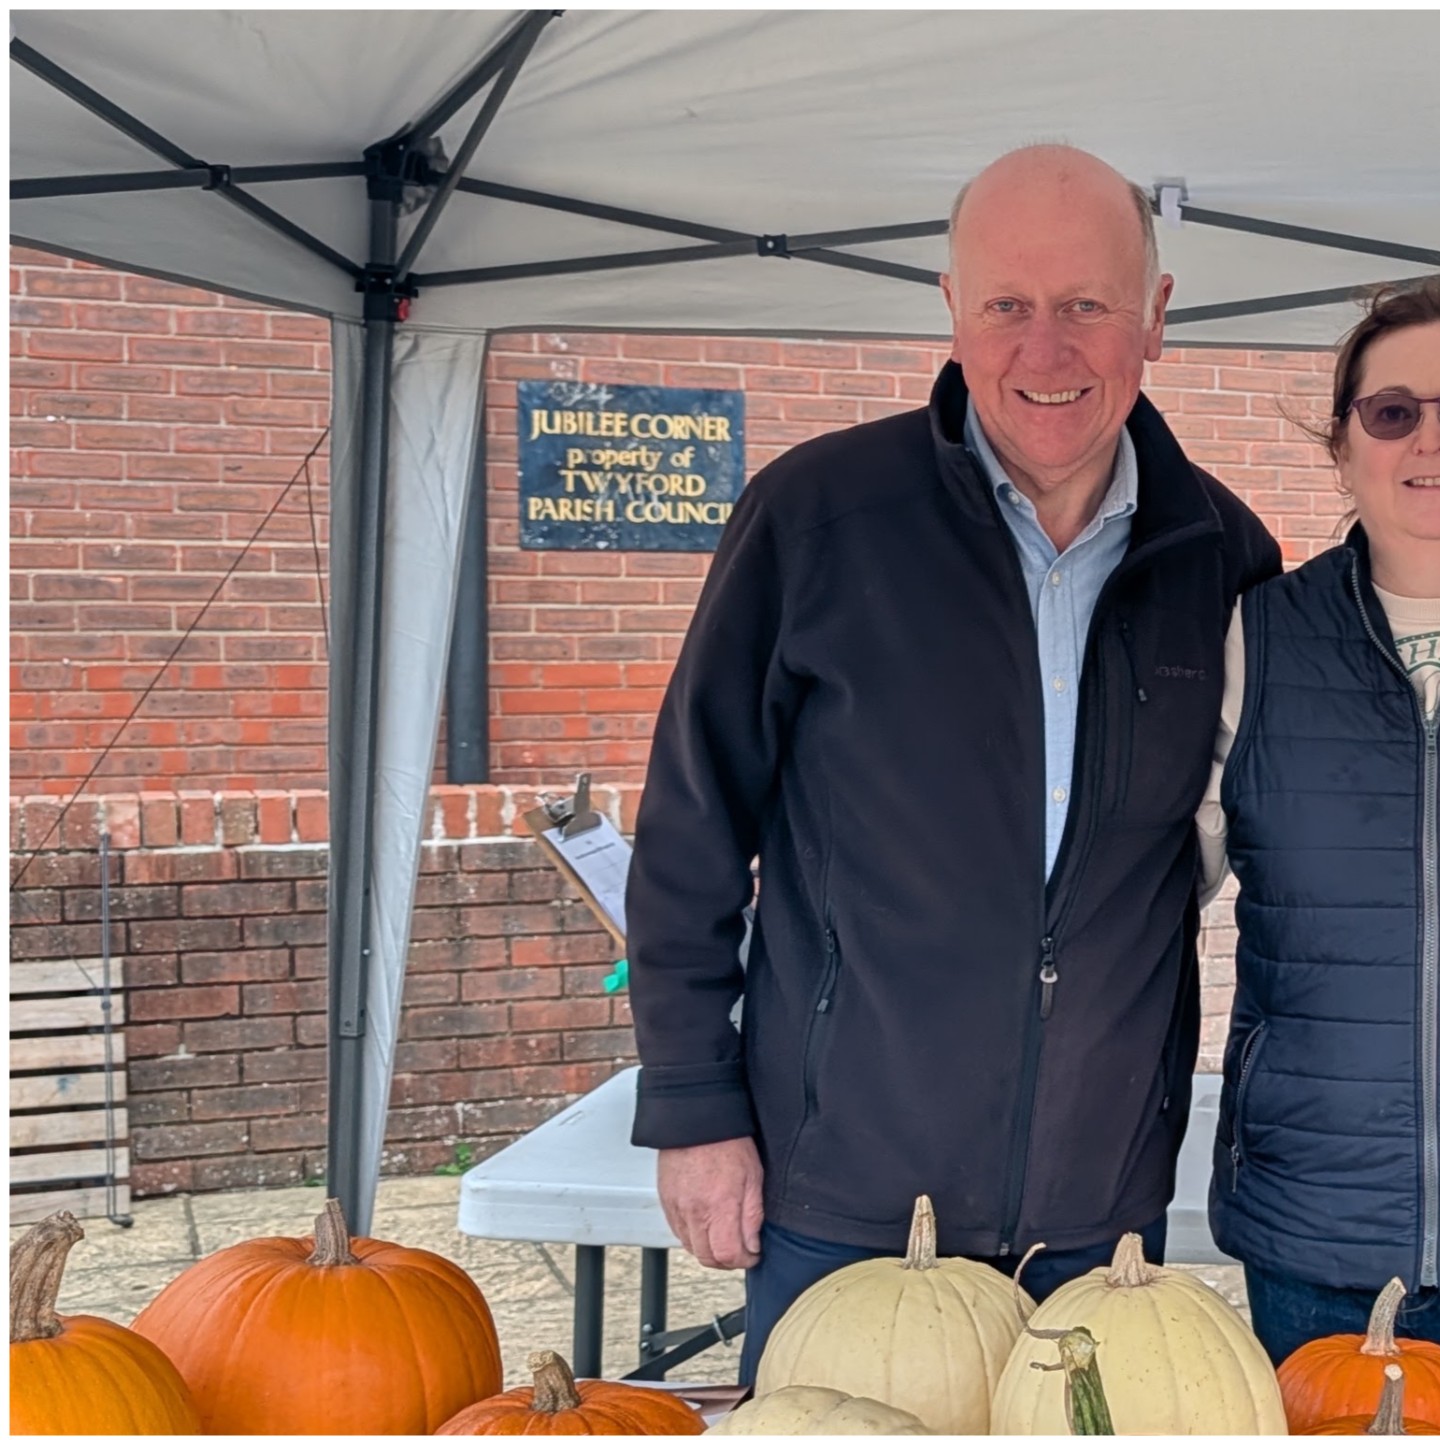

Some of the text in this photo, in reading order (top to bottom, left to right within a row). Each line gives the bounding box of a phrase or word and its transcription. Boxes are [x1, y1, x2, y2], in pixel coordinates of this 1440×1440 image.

[529, 410, 732, 442] JUBILEE CORNER
[670, 446, 696, 467] of
[558, 470, 707, 497] TWYFORD
[527, 497, 614, 522] PARISH
